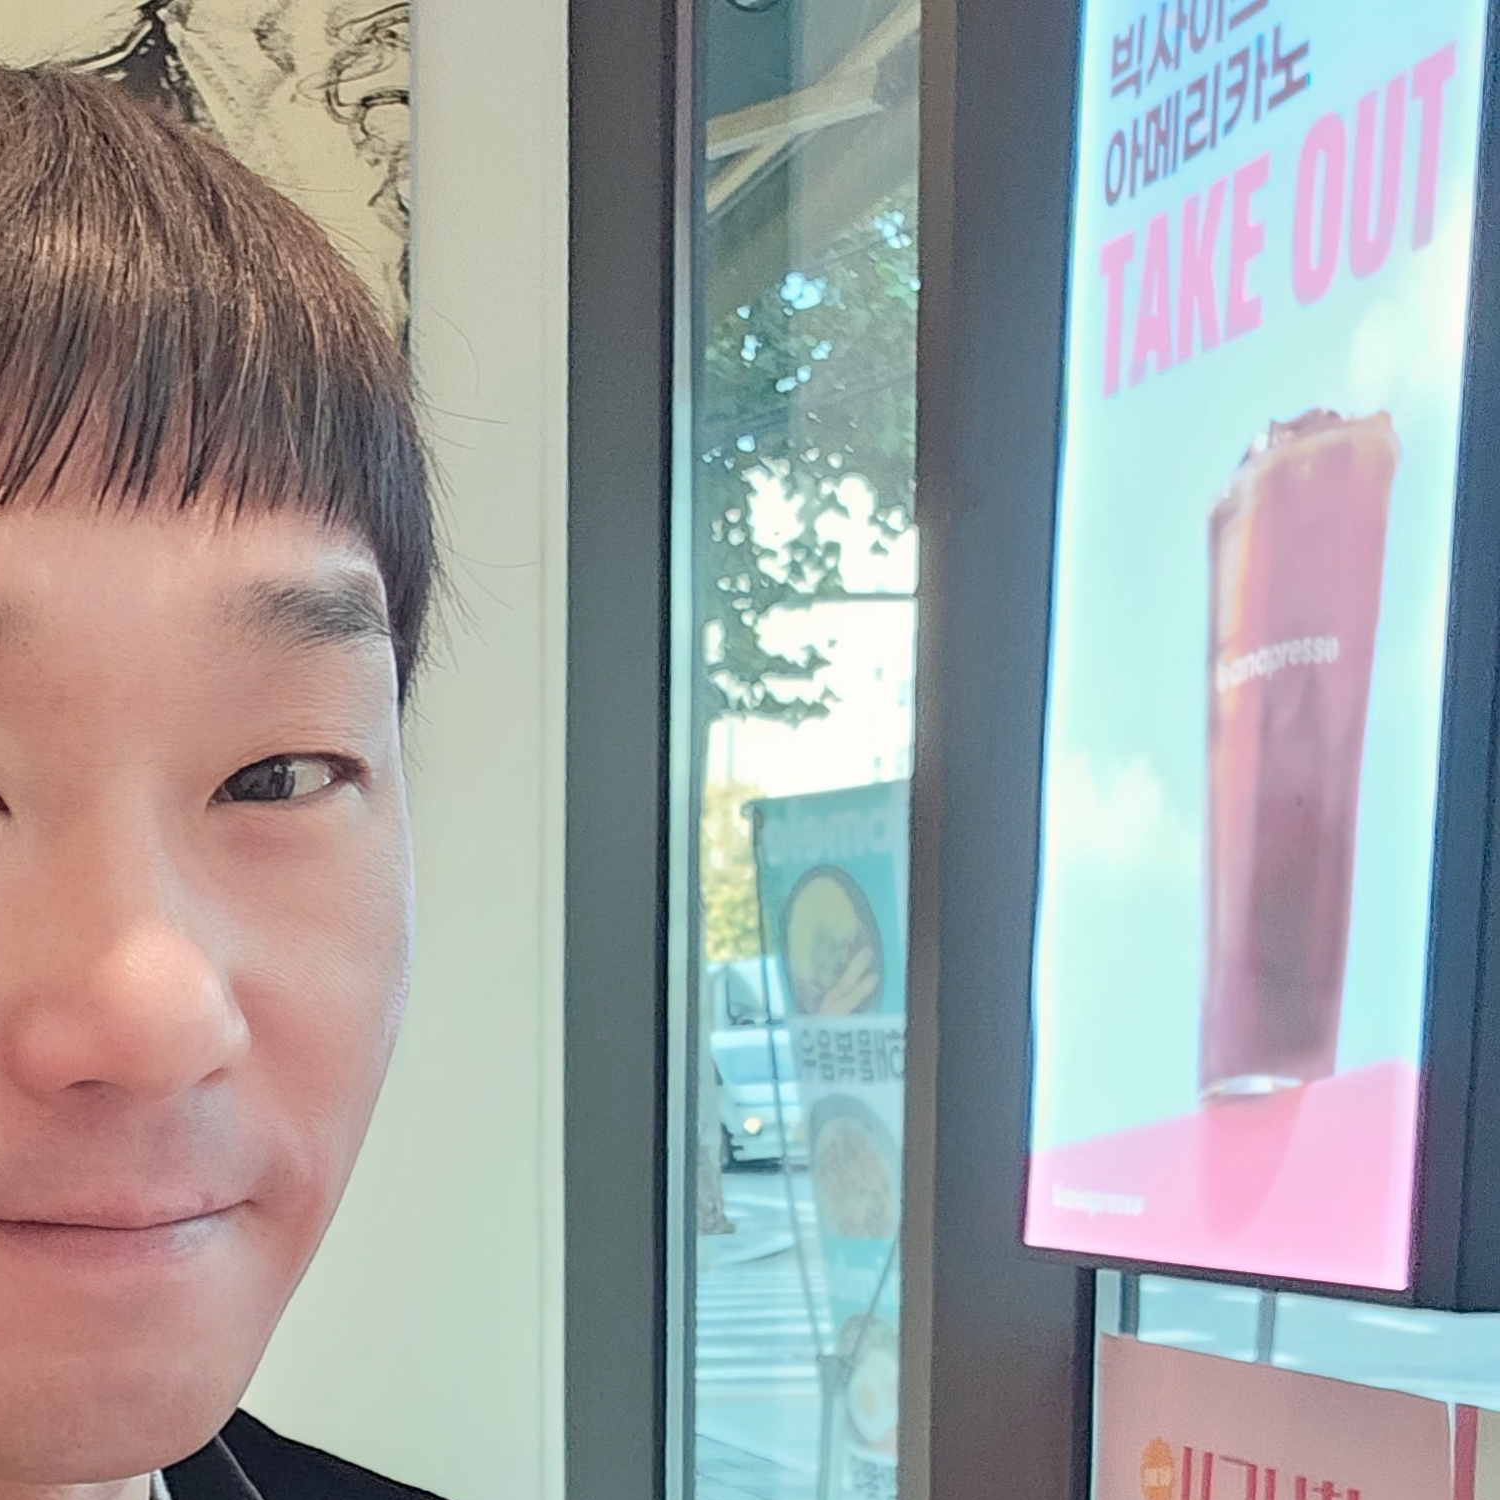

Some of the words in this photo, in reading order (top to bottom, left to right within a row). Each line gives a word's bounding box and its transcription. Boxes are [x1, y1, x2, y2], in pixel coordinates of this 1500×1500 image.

[1100, 151, 1272, 400] TAKE
[1293, 38, 1457, 306] OUT
[1105, 23, 1311, 207] 아메리카노
